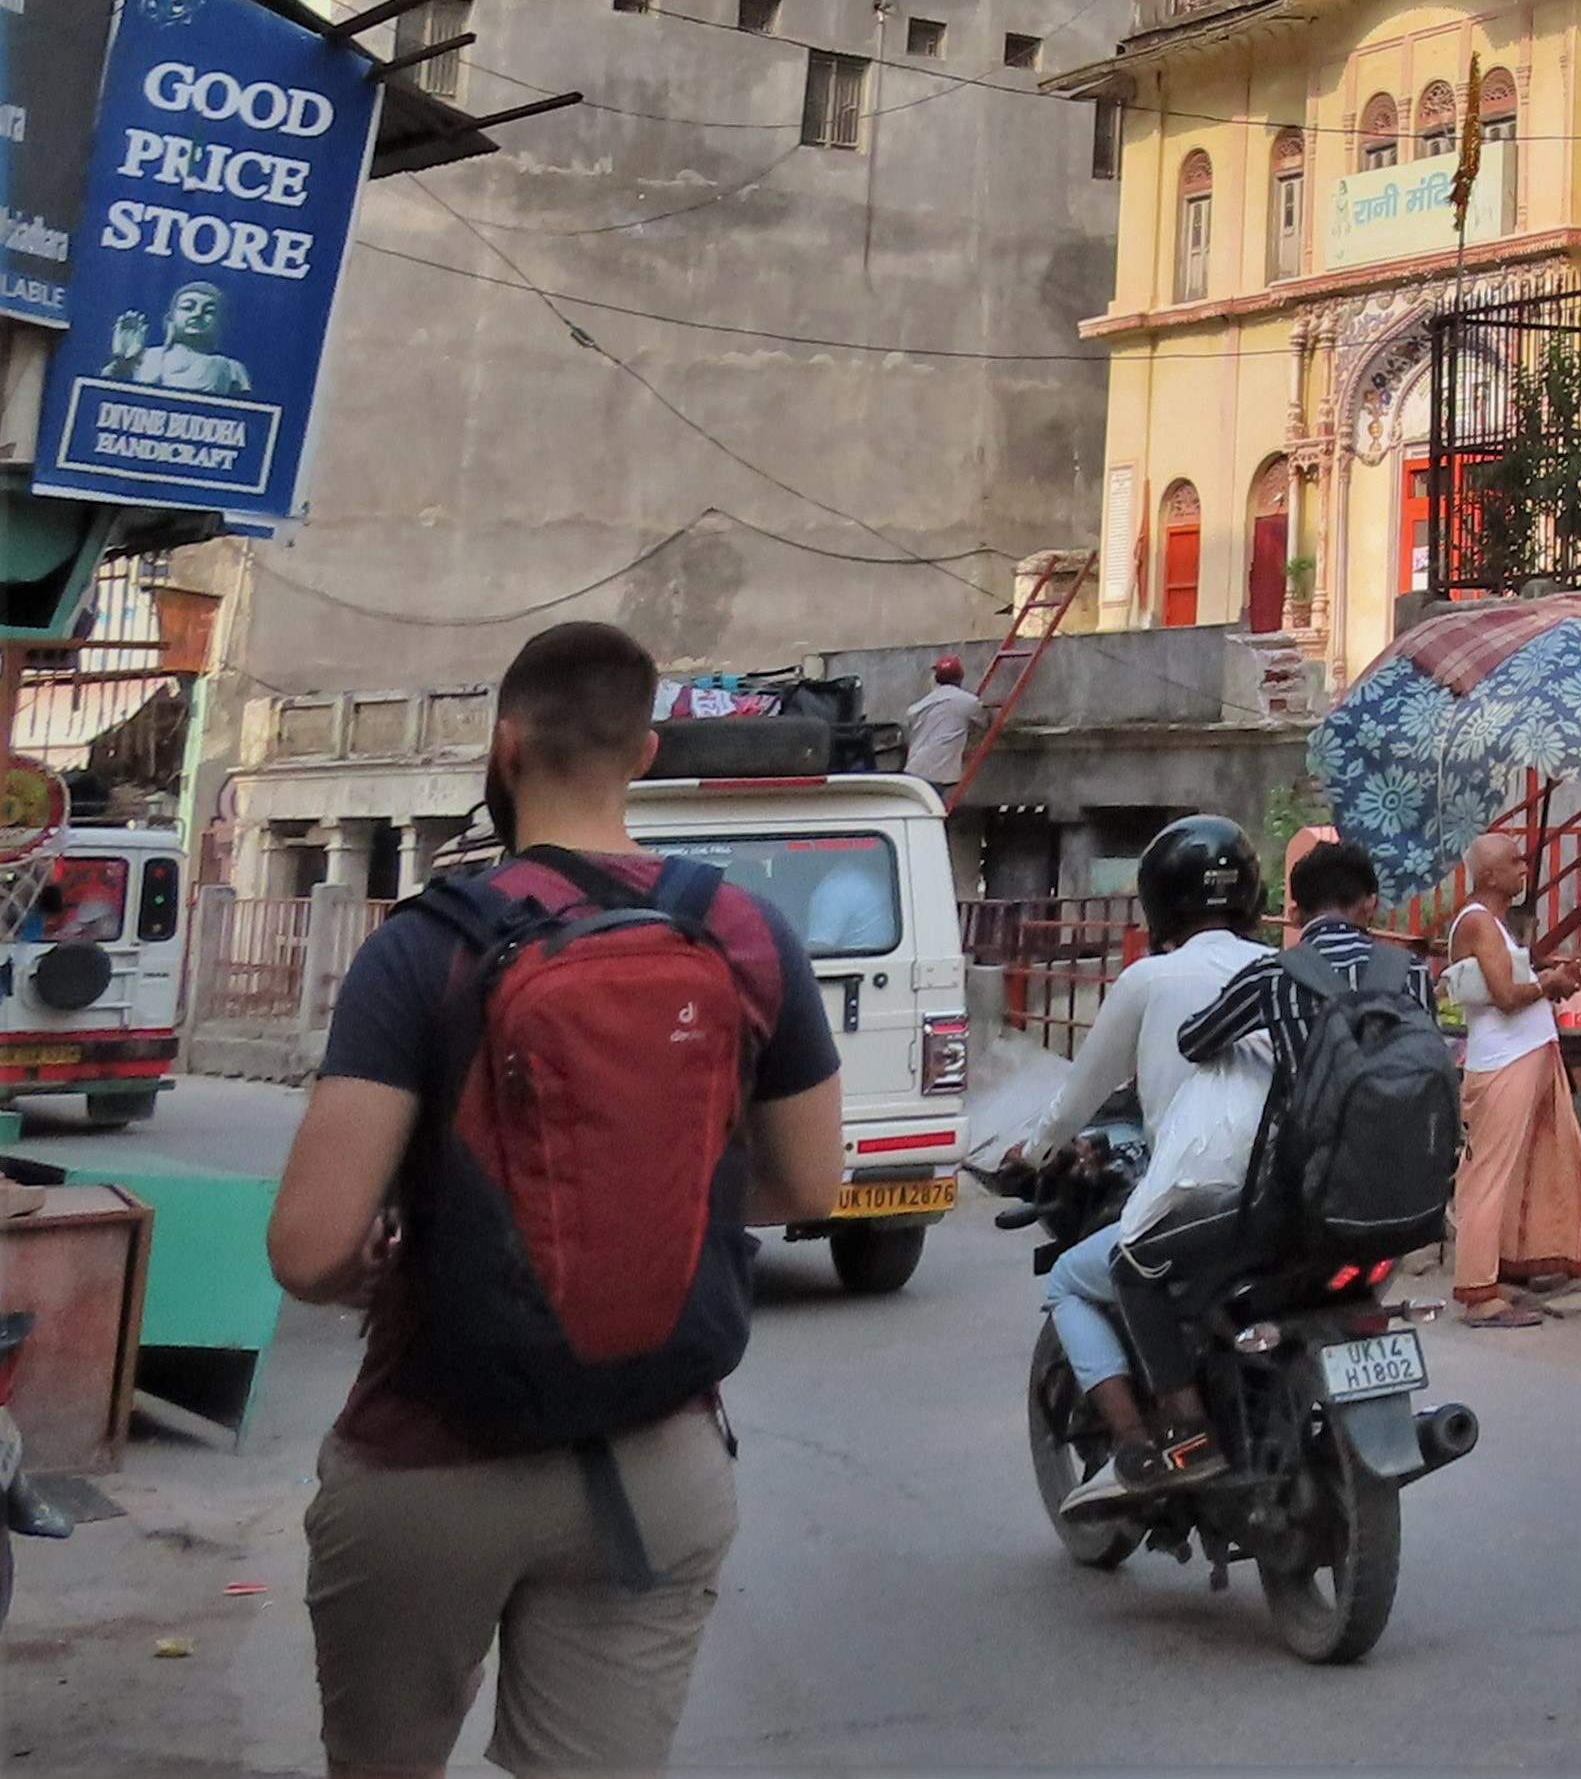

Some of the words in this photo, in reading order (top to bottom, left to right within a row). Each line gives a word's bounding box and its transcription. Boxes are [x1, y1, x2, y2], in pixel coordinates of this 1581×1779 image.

[144, 60, 334, 140] GOOD
[118, 128, 311, 209] PRICE
[1352, 183, 1400, 225] रानी
[1406, 171, 1455, 213] मंदि
[101, 200, 313, 280] STORE
[0, 274, 66, 309] LABLE
[96, 402, 167, 434] DIVINE
[167, 412, 247, 448] BUDDHA
[94, 432, 239, 471] HANDICRAFT
[1345, 1359, 1415, 1389] H1802
